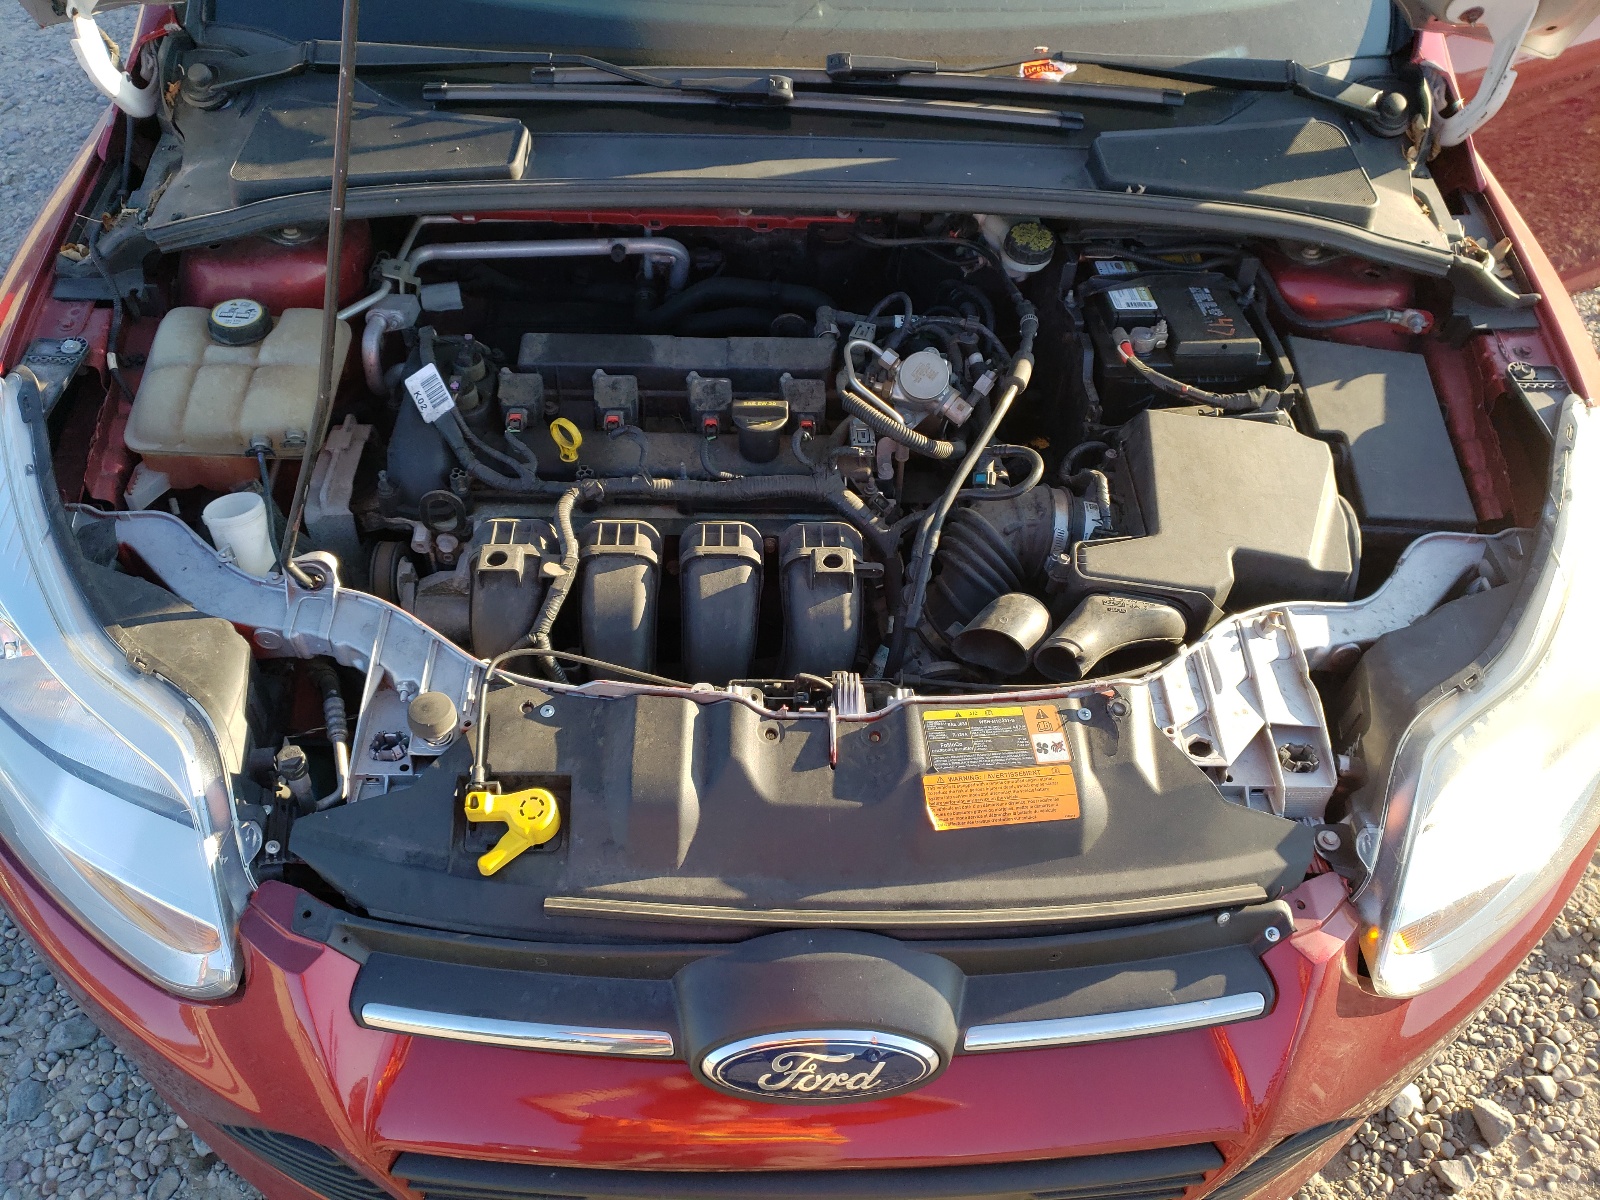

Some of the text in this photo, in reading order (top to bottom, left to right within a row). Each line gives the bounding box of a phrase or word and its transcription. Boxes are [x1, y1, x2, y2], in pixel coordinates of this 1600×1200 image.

[1024, 64, 1058, 75] LICENSE
[413, 390, 428, 411] K02
[987, 769, 1041, 779] AVERTISSEMENT
[757, 1051, 886, 1092] Ford
